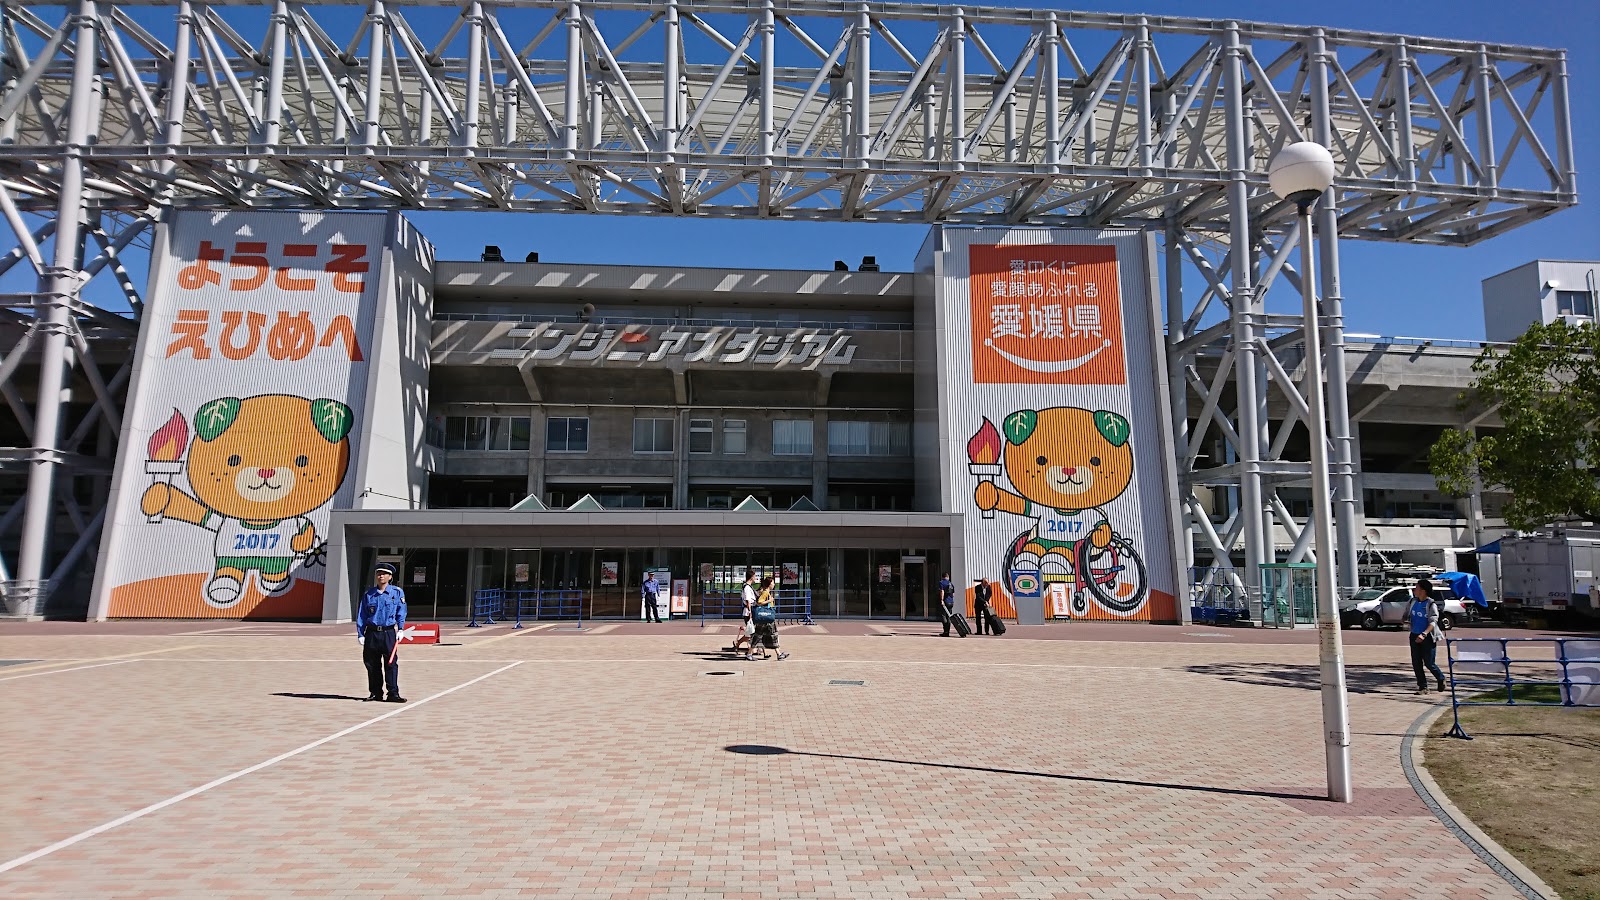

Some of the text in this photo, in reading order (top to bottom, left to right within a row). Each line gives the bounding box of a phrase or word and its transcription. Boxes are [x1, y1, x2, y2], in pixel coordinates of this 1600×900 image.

[177, 241, 369, 293] ようこそ
[1010, 260, 1077, 276] 愛のくに
[991, 281, 1099, 298] 愛顔あふれる
[991, 303, 1102, 339] 愛媛県
[165, 310, 364, 361] えひめへ
[489, 327, 857, 370] ニンジニアスタジアム
[1047, 519, 1083, 534] 2017
[234, 534, 281, 549] 2017
